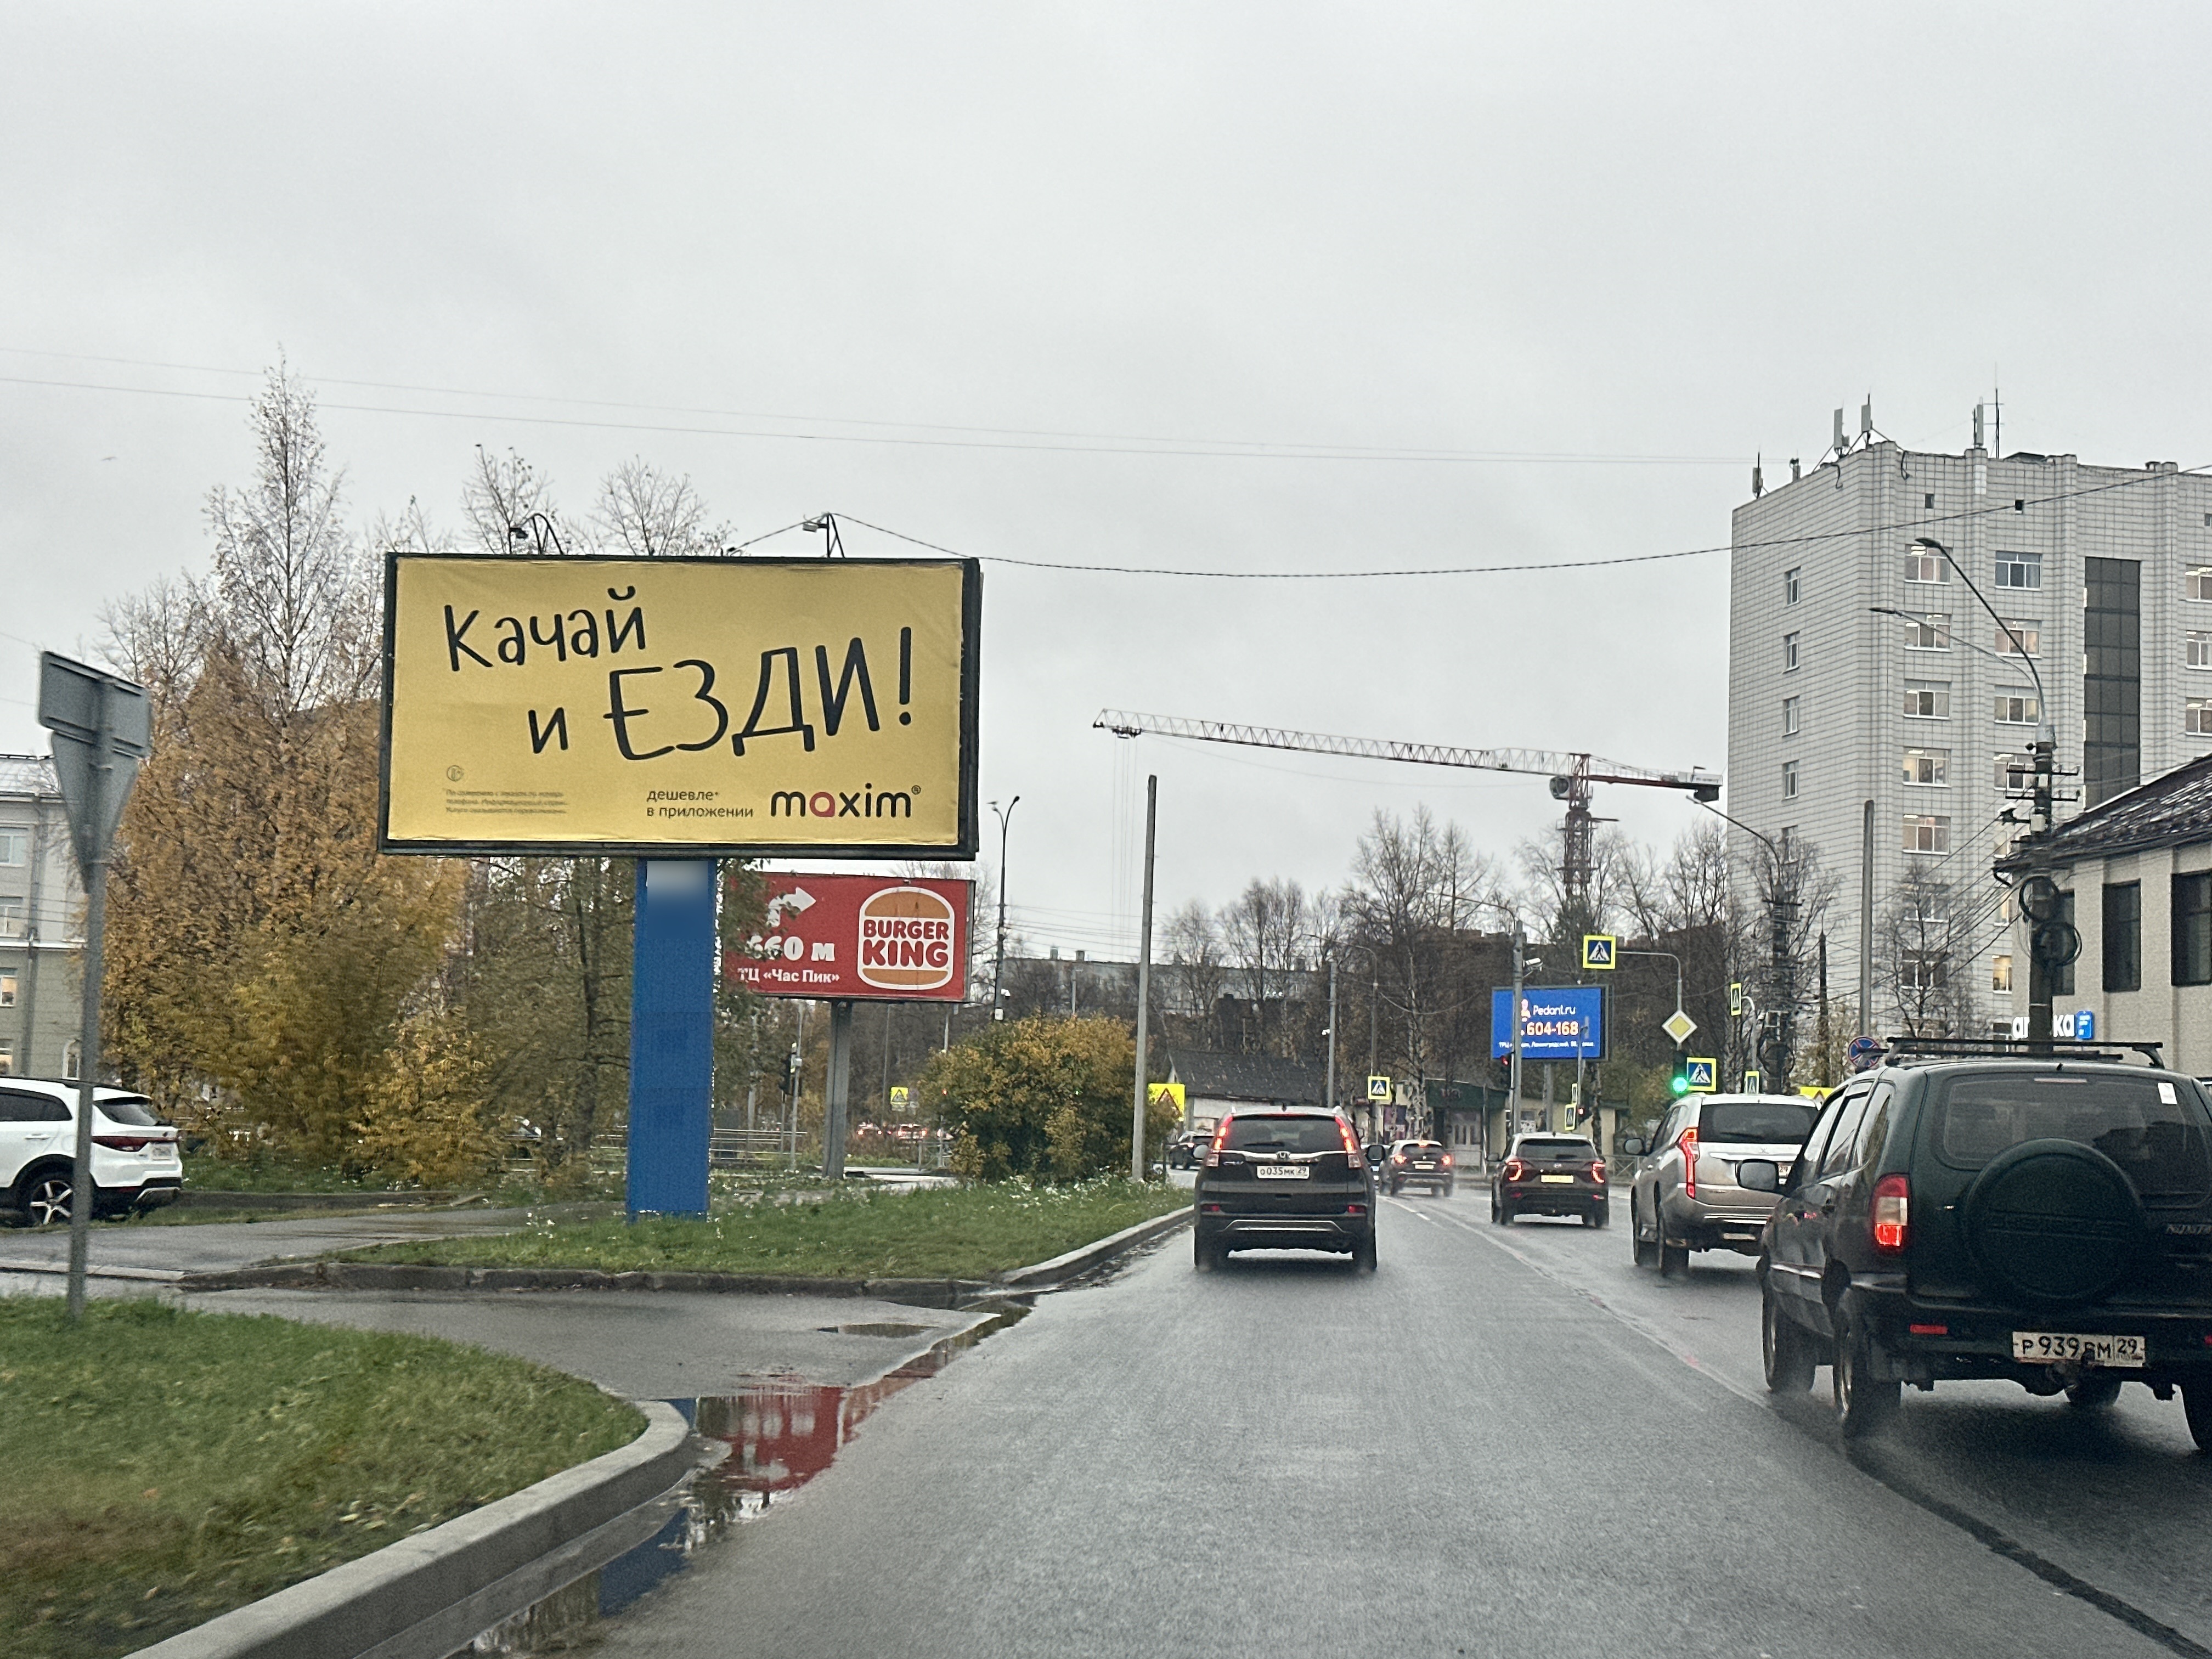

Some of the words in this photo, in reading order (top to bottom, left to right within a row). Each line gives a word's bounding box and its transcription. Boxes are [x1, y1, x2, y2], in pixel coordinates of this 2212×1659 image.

[444, 585, 646, 672] Качай
[528, 707, 568, 754] и
[603, 627, 912, 761] ЕЗДИ!
[647, 807, 654, 816] в
[659, 808, 753, 819] приложении
[864, 919, 949, 940] BURGER
[811, 943, 836, 962] м
[862, 939, 949, 968] KING
[737, 967, 760, 983] ТЦ
[763, 968, 800, 982] «Час
[802, 969, 840, 983] Пик»
[1533, 1005, 1576, 1015] Pedant.ru
[1526, 1021, 1579, 1036] 604-168
[2117, 1338, 2137, 1355] 29
